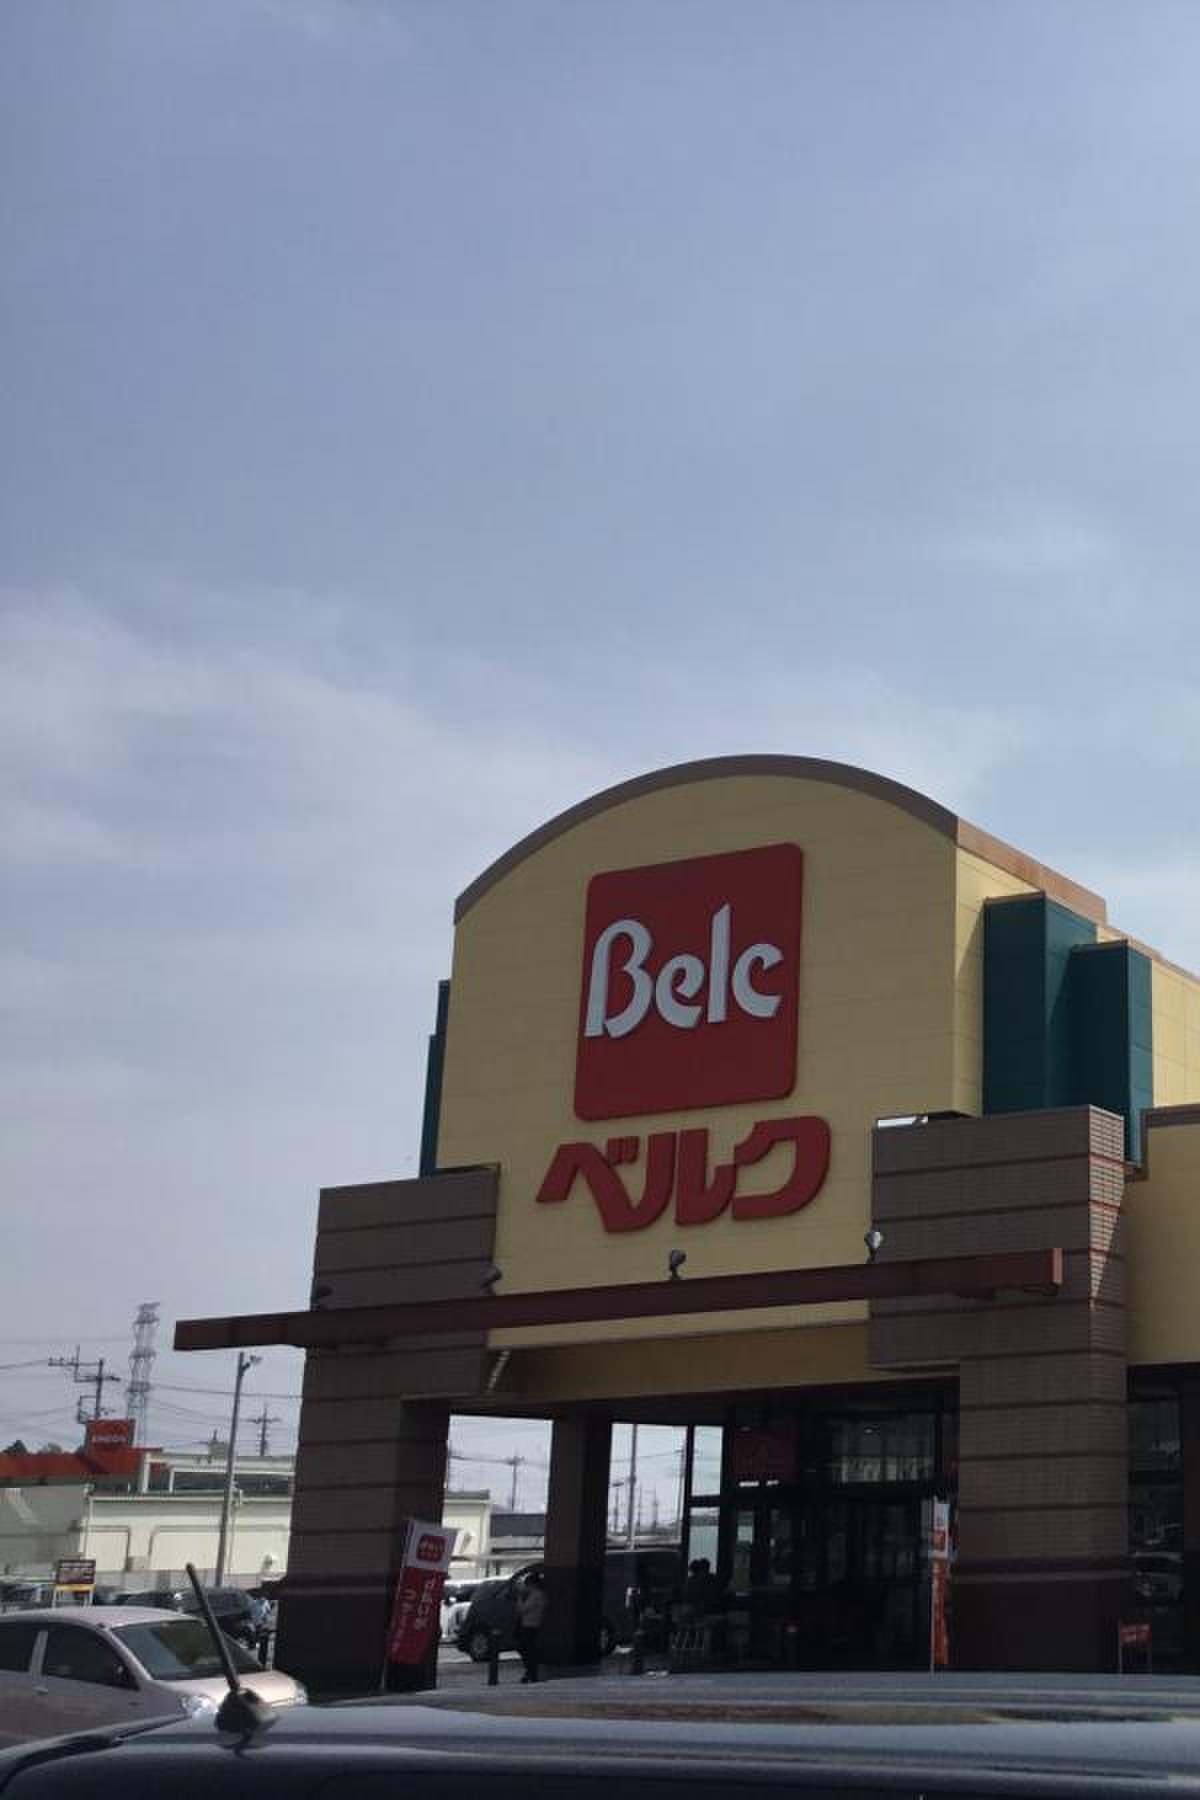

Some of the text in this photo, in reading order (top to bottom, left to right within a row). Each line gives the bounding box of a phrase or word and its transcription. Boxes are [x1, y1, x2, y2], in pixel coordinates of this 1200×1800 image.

[584, 903, 785, 1038] Belc
[536, 1115, 832, 1234] ベルク
